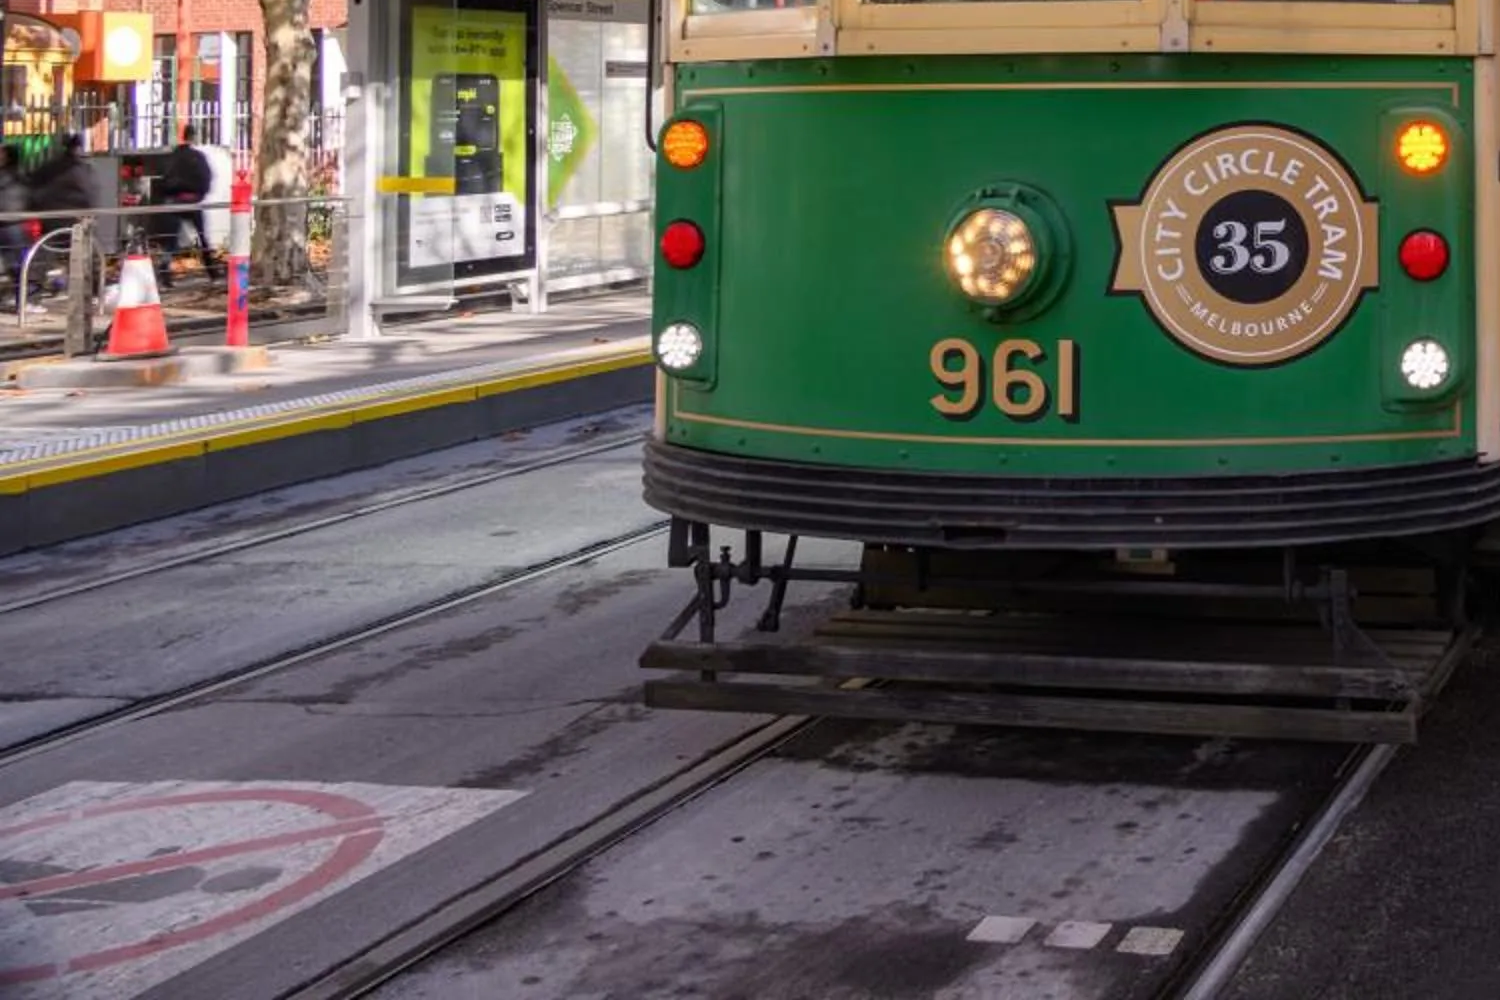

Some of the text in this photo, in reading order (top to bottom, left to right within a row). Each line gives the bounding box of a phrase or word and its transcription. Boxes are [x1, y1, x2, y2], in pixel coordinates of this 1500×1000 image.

[1154, 149, 1347, 281] CITY CIRCLE TRAM
[1208, 218, 1290, 275] 35
[1190, 302, 1313, 337] MELBOURNE
[929, 339, 1077, 418] 961
